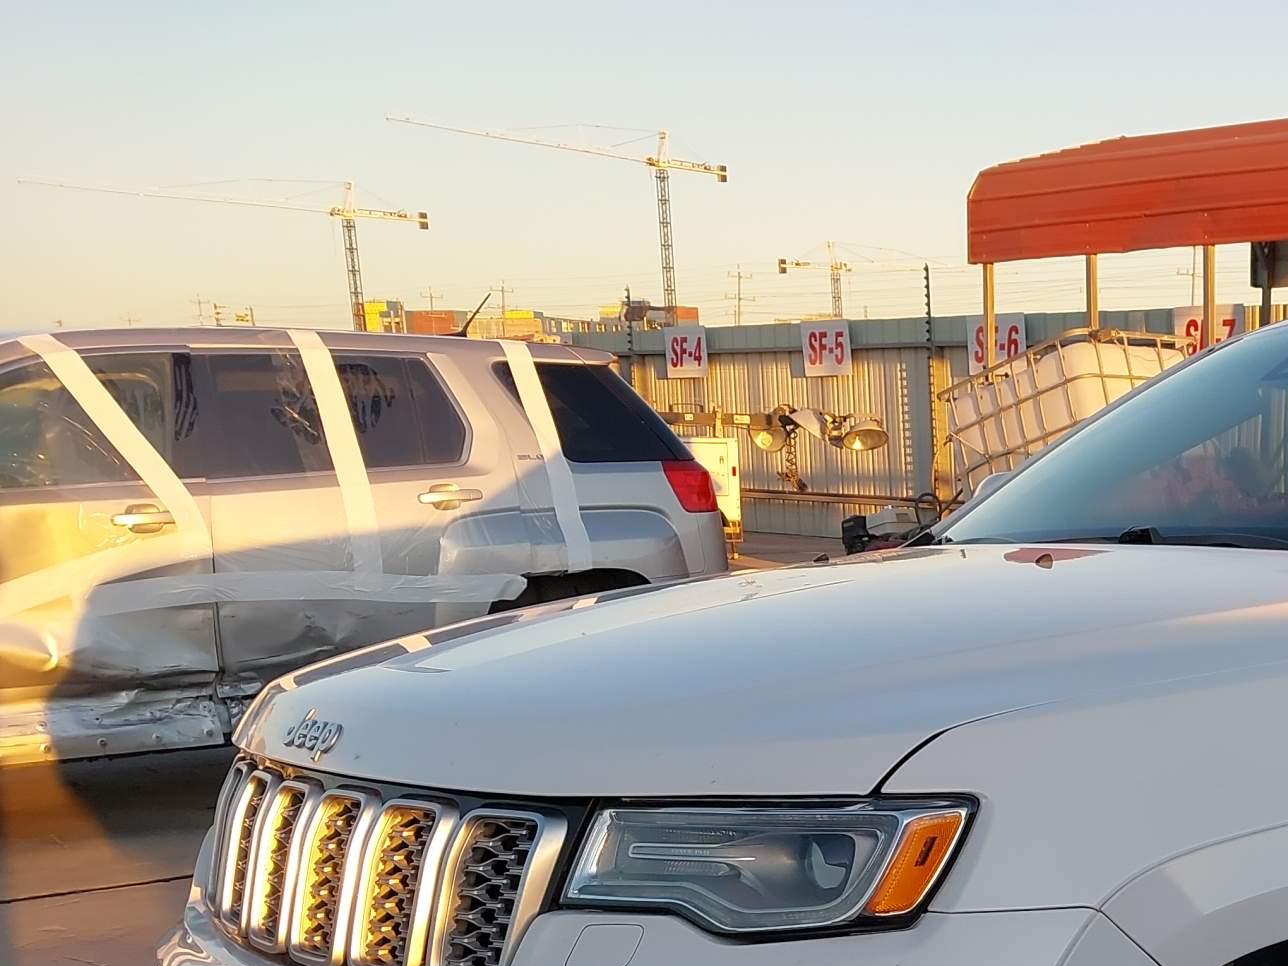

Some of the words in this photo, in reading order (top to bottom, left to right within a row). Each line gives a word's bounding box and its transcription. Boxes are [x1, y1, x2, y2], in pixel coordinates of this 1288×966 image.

[671, 336, 702, 368] SF-4
[808, 331, 844, 366] SF-5
[975, 325, 1019, 364] S-6
[1186, 319, 1236, 356] S-7
[283, 708, 345, 762] Jeep
